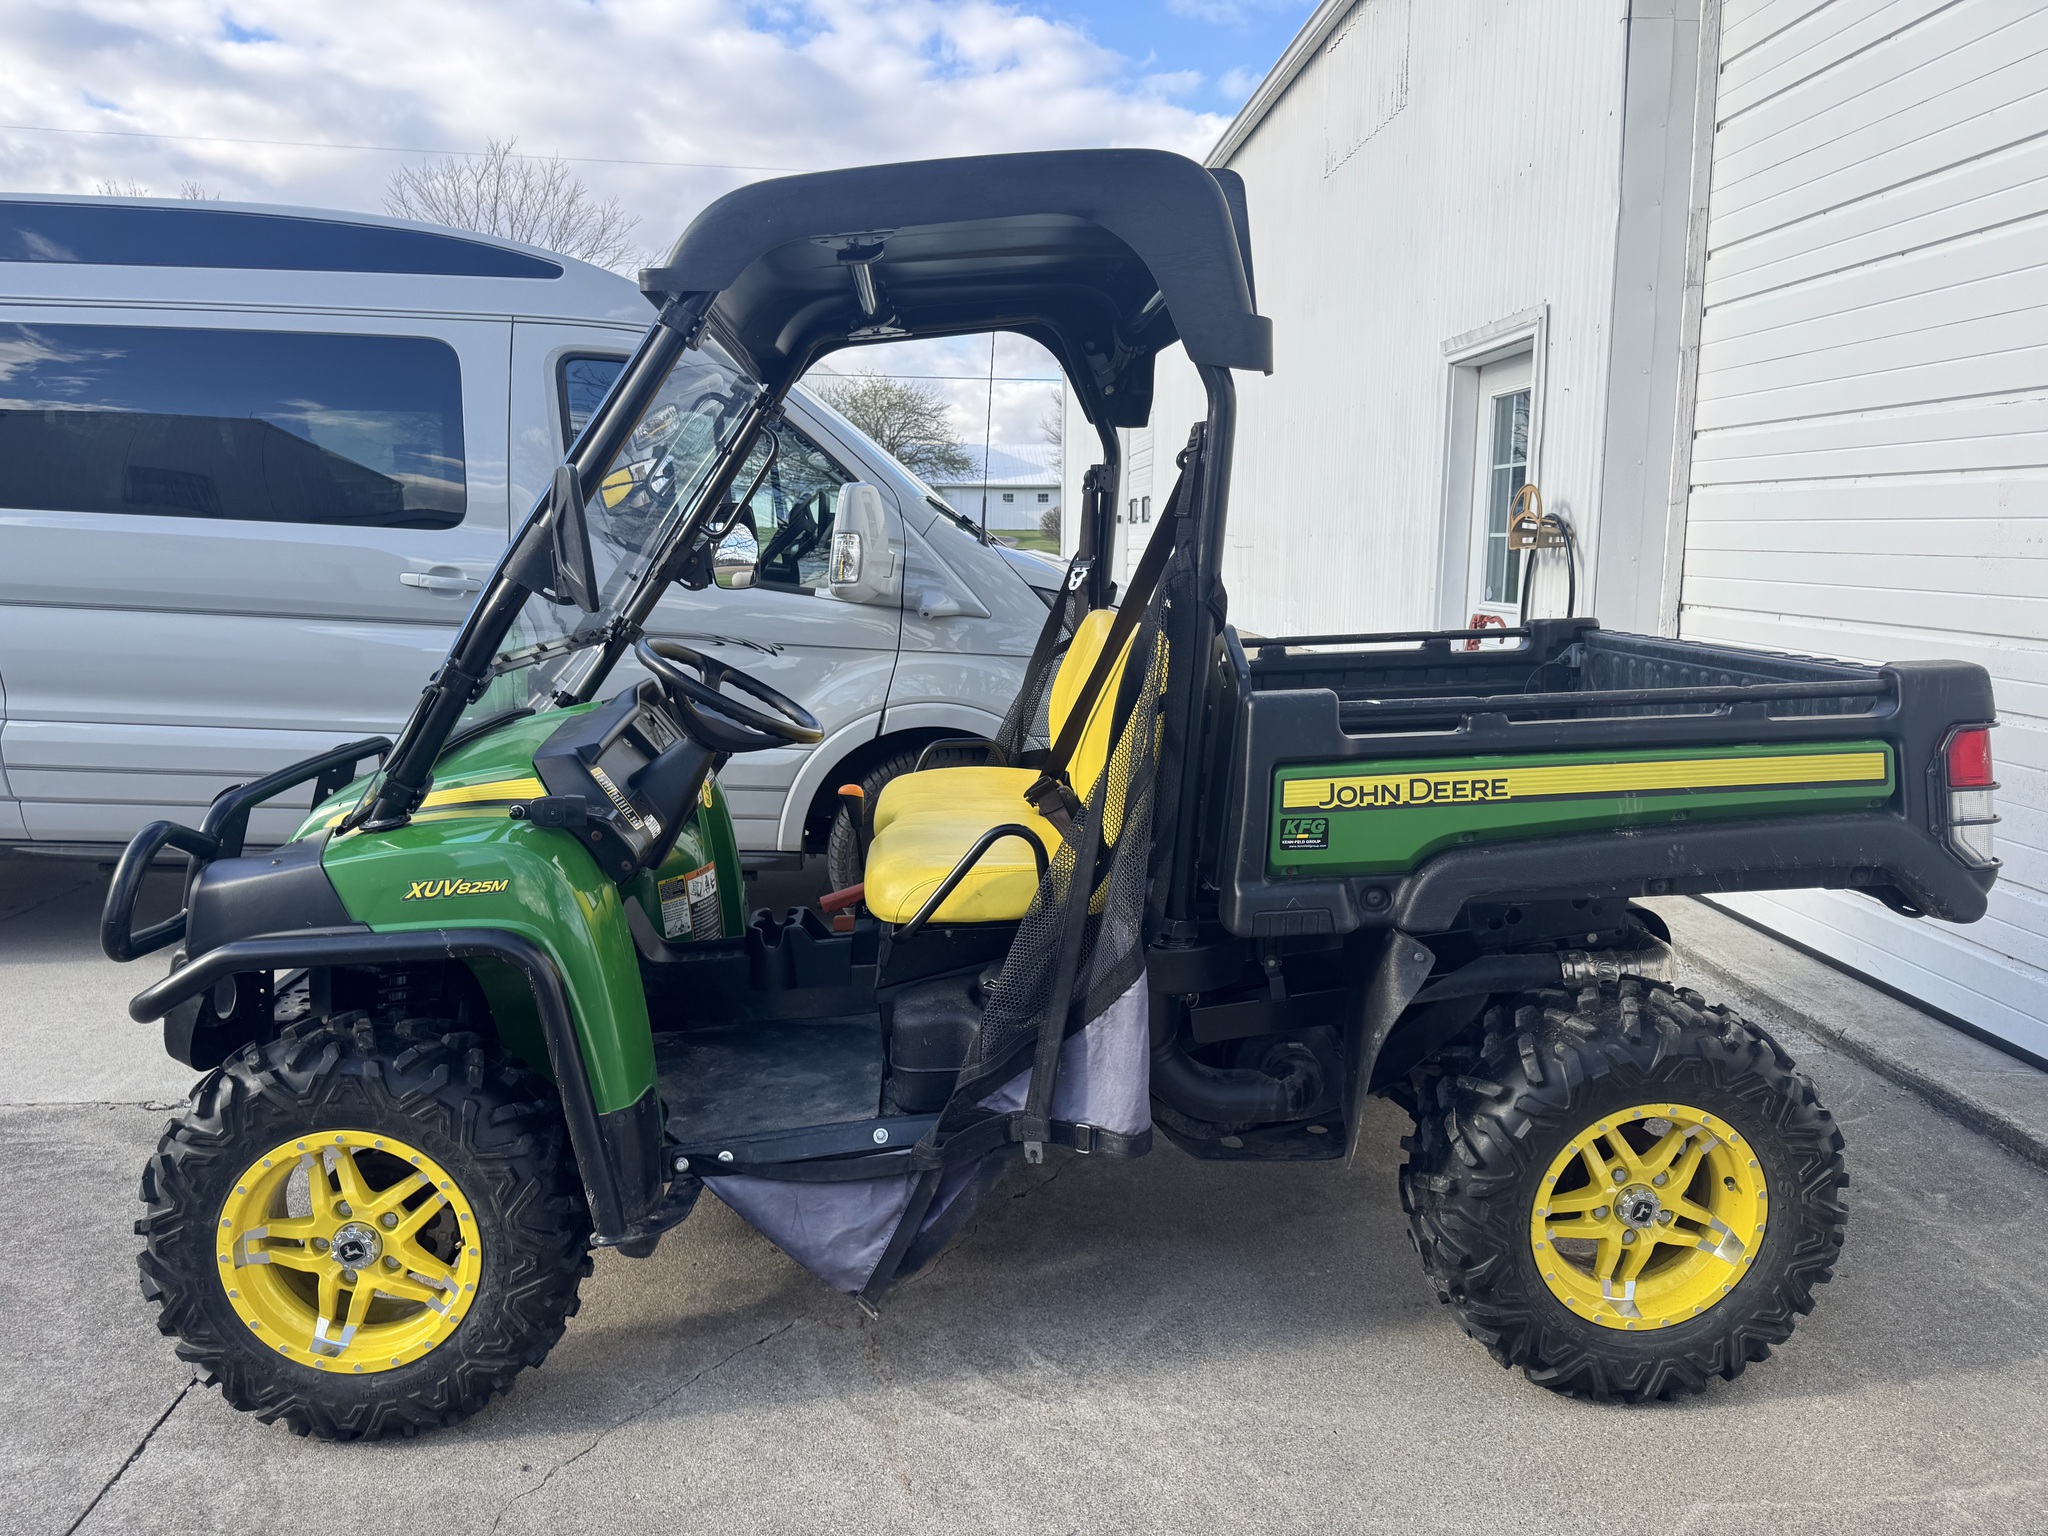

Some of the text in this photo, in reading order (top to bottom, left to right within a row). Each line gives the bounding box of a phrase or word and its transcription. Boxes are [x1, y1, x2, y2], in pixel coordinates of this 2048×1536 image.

[1318, 777, 1509, 807] JOHN DEERE
[1284, 819, 1326, 834] KFG
[404, 878, 510, 900] XUV825M
